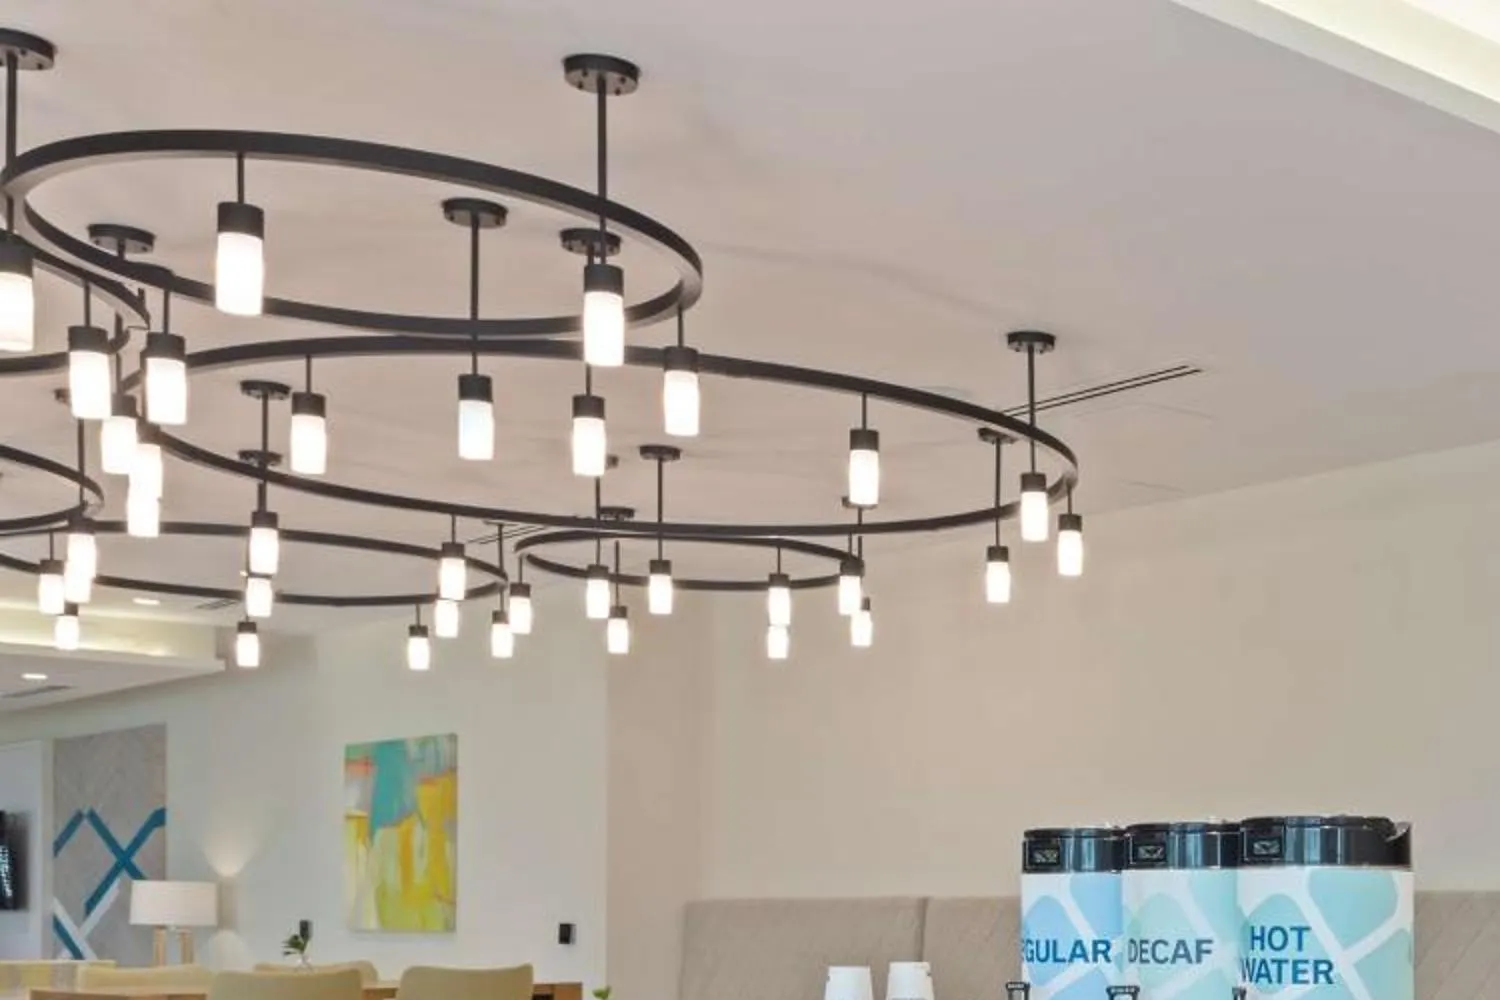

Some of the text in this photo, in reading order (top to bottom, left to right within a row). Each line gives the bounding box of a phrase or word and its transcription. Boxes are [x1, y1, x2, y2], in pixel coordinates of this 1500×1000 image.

[1021, 938, 1112, 963] GULAR
[1127, 938, 1213, 964] DECAF
[1250, 925, 1311, 952] HOT
[1240, 957, 1334, 985] WATER
